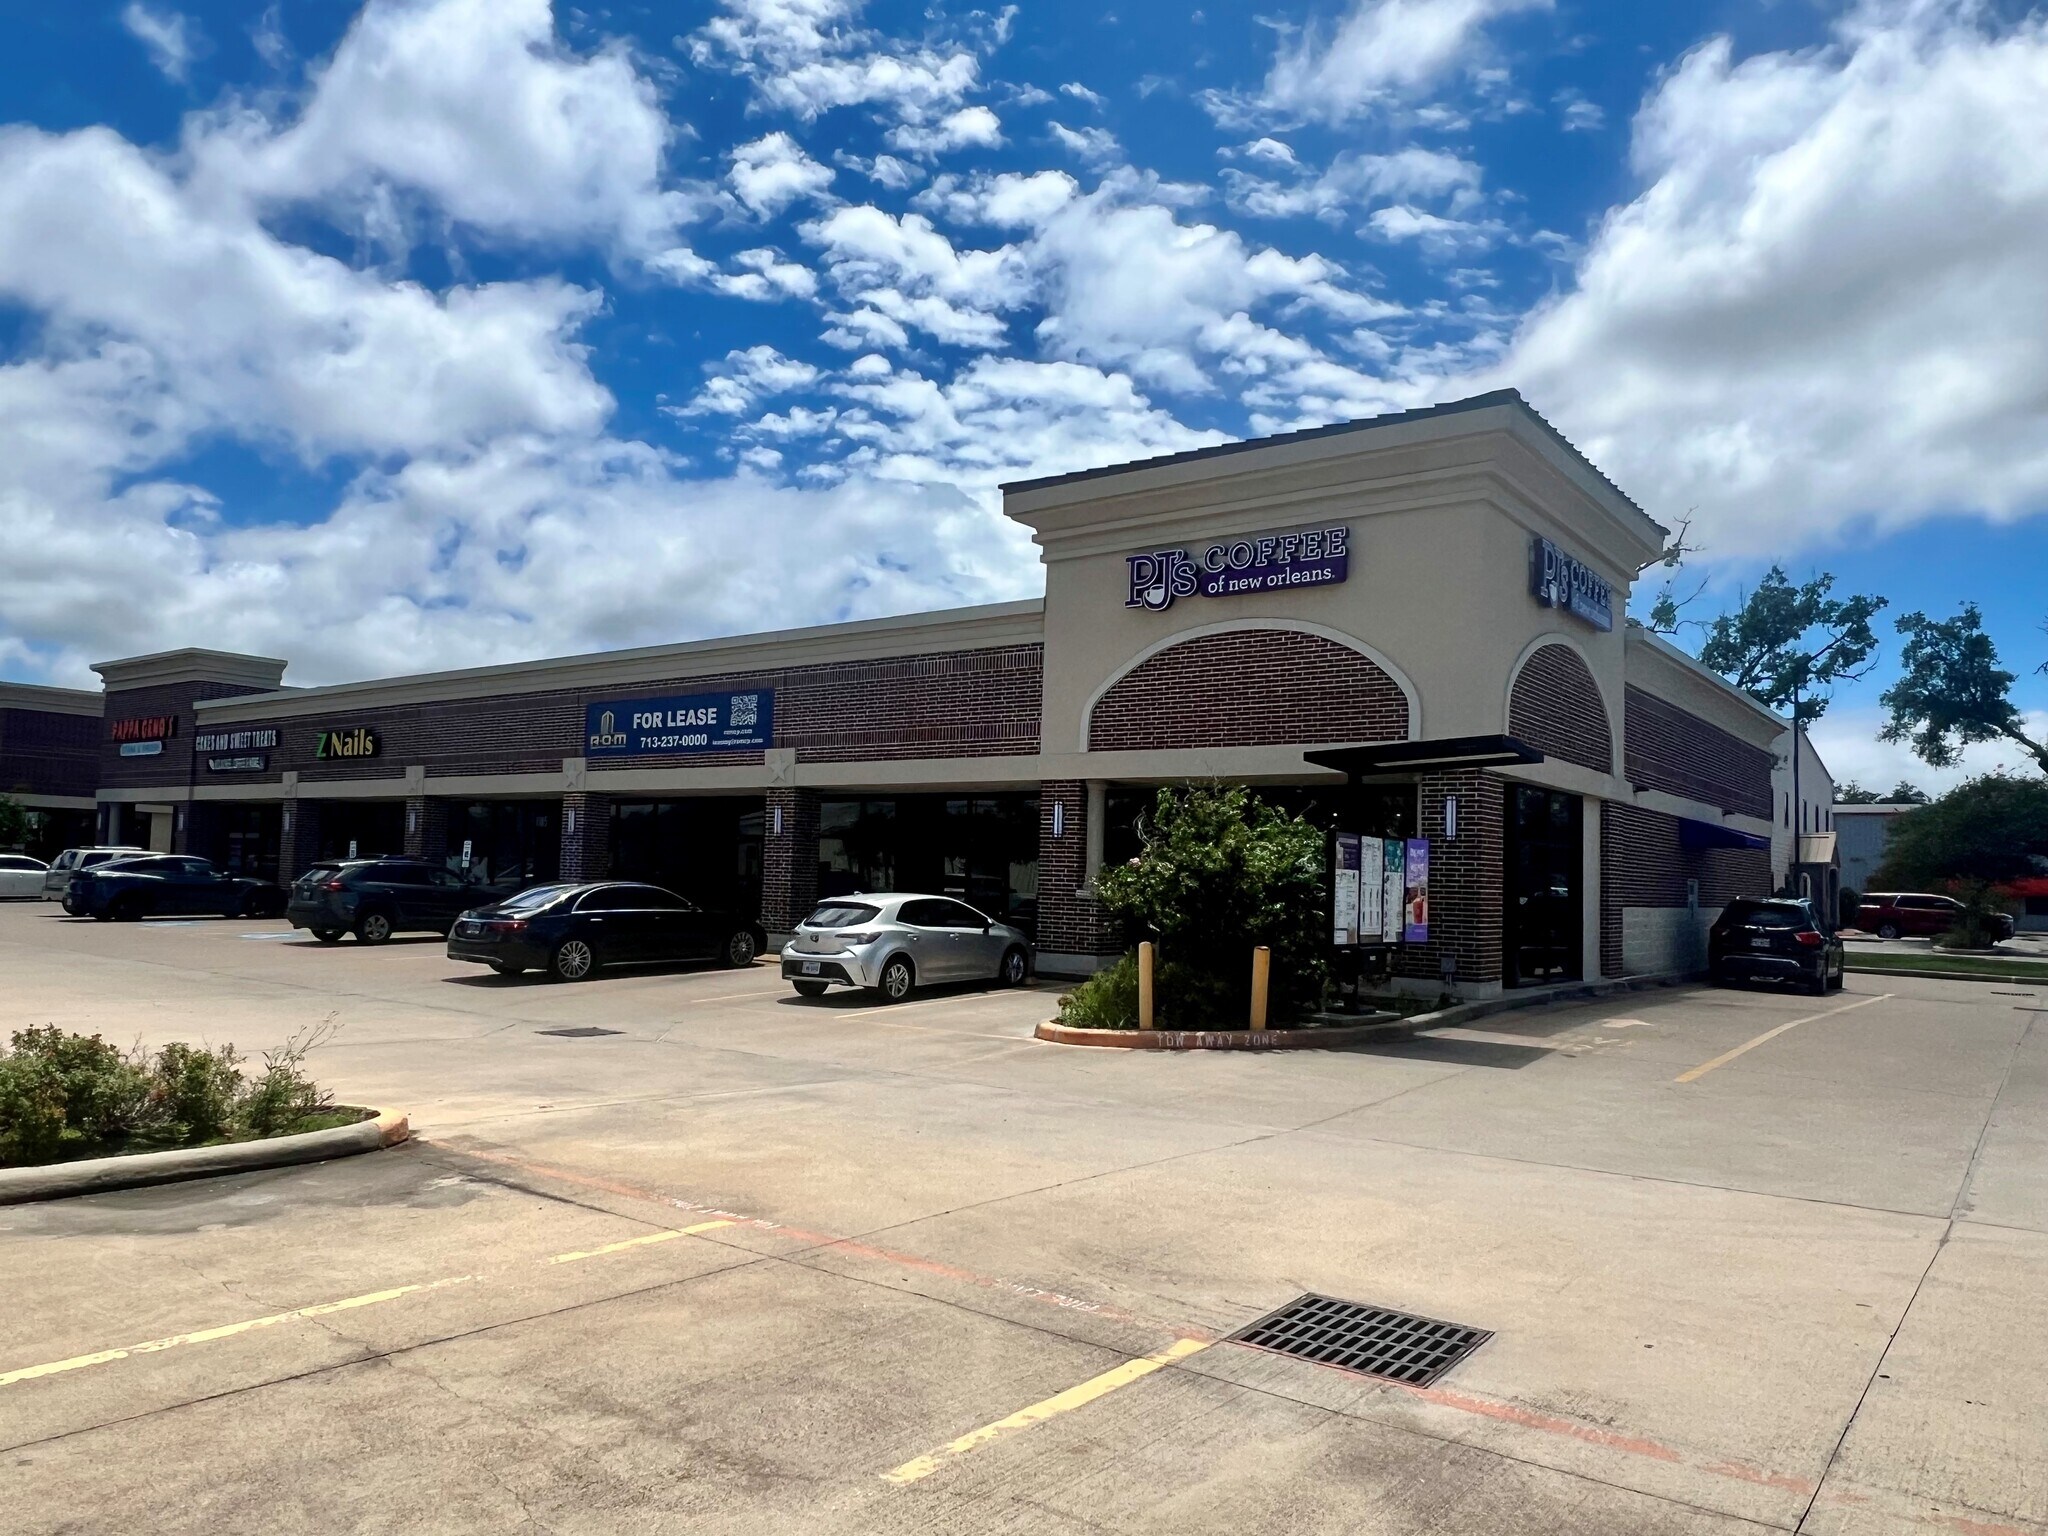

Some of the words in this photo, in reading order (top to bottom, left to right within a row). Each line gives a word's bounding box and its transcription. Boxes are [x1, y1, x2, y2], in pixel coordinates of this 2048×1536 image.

[1203, 526, 1347, 573] COFFEE
[1125, 549, 1198, 611] PJ's
[1207, 575, 1226, 594] of
[1228, 576, 1263, 592] new
[633, 712, 663, 729] FOR
[666, 707, 718, 728] LEASE
[316, 732, 328, 757] Z
[330, 728, 373, 757] Nails
[640, 733, 708, 749] 713-237-0000
[1155, 1031, 1185, 1047] TOW
[1196, 1031, 1233, 1047] AWAY
[1244, 1034, 1279, 1047] ZONE
